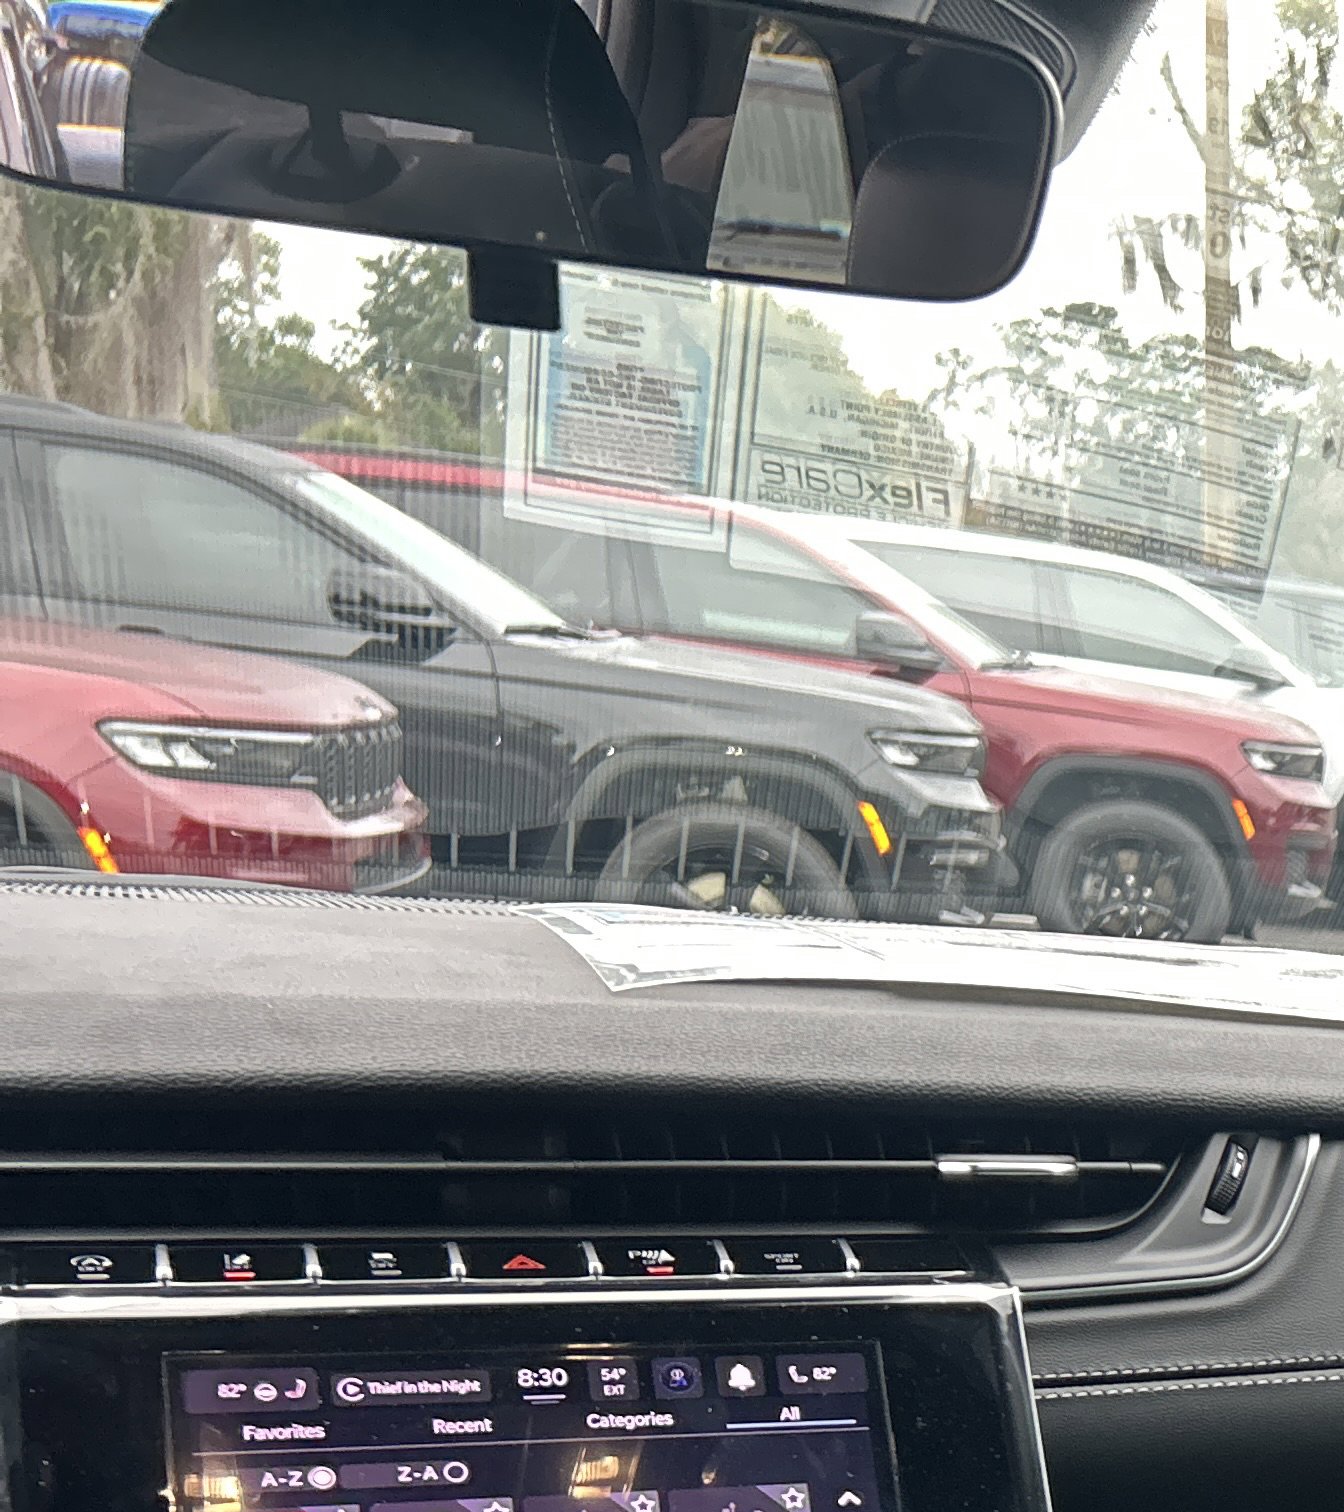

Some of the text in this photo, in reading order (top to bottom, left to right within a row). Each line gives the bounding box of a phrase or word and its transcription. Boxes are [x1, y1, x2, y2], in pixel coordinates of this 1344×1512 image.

[516, 1367, 569, 1388] 8:30
[600, 1366, 627, 1382] 54°
[366, 1379, 482, 1396] Thief in the Night
[602, 1384, 626, 1396] EXT
[586, 1409, 674, 1430] Categories
[779, 1405, 801, 1421] All
[242, 1423, 326, 1441] Favorites
[432, 1415, 493, 1435] Recent
[260, 1469, 304, 1488] A-Z
[396, 1464, 440, 1483] Z-A
